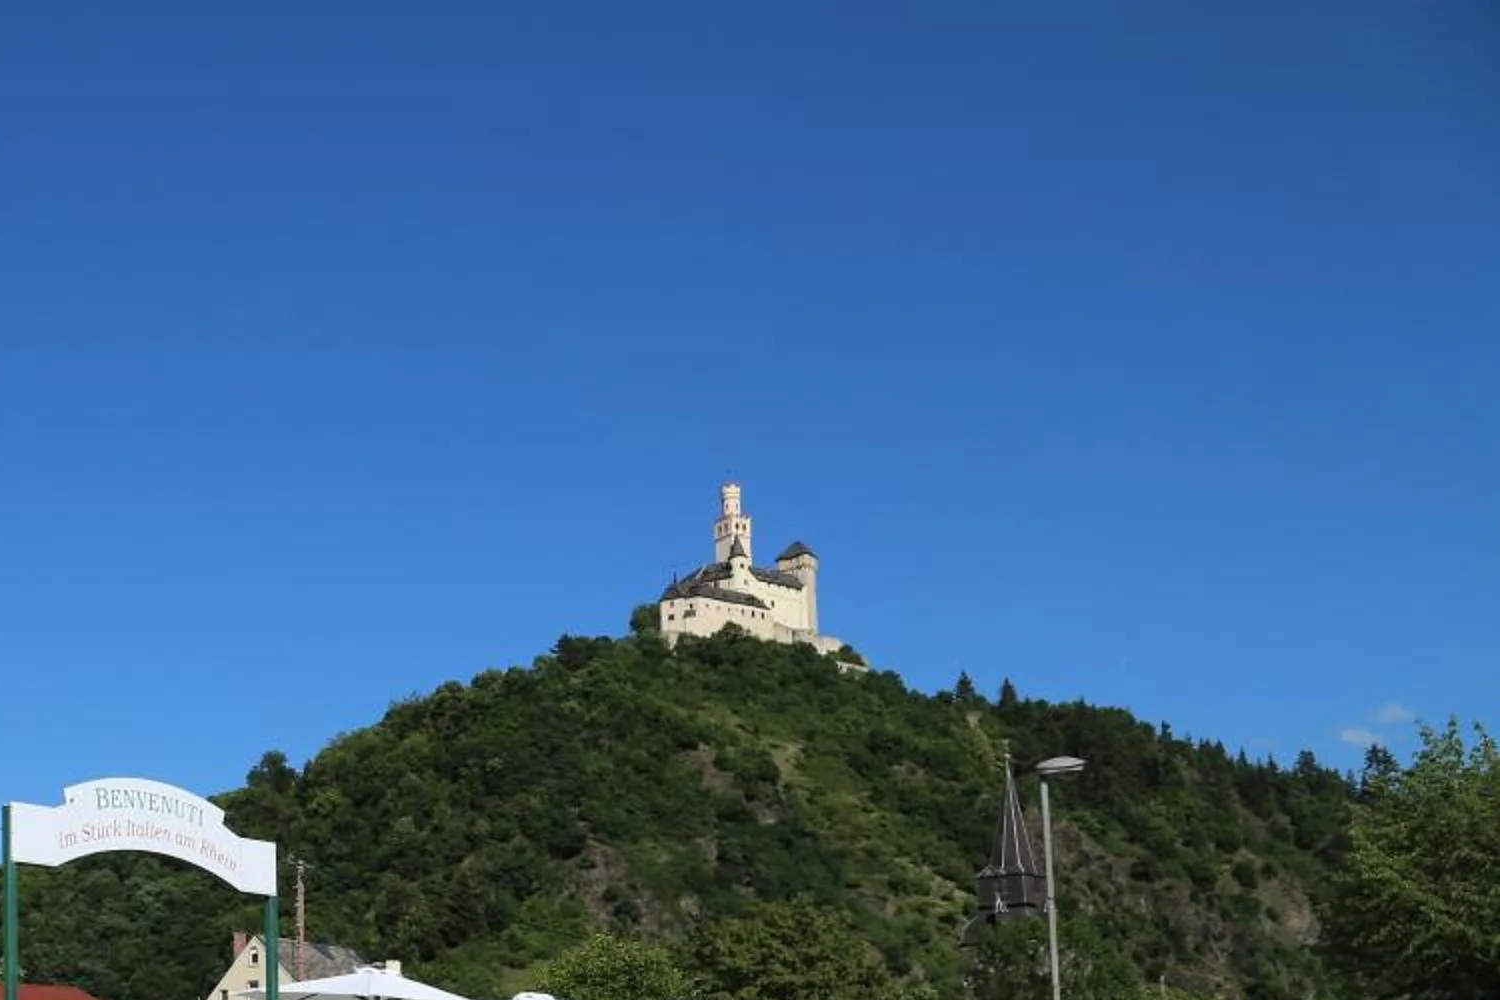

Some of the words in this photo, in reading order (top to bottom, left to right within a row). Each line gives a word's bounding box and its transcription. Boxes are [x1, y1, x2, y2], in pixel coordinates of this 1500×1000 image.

[95, 787, 204, 827] BENVENUTI
[126, 818, 171, 841] Italien
[174, 831, 196, 849] am
[199, 838, 238, 872] Rhein
